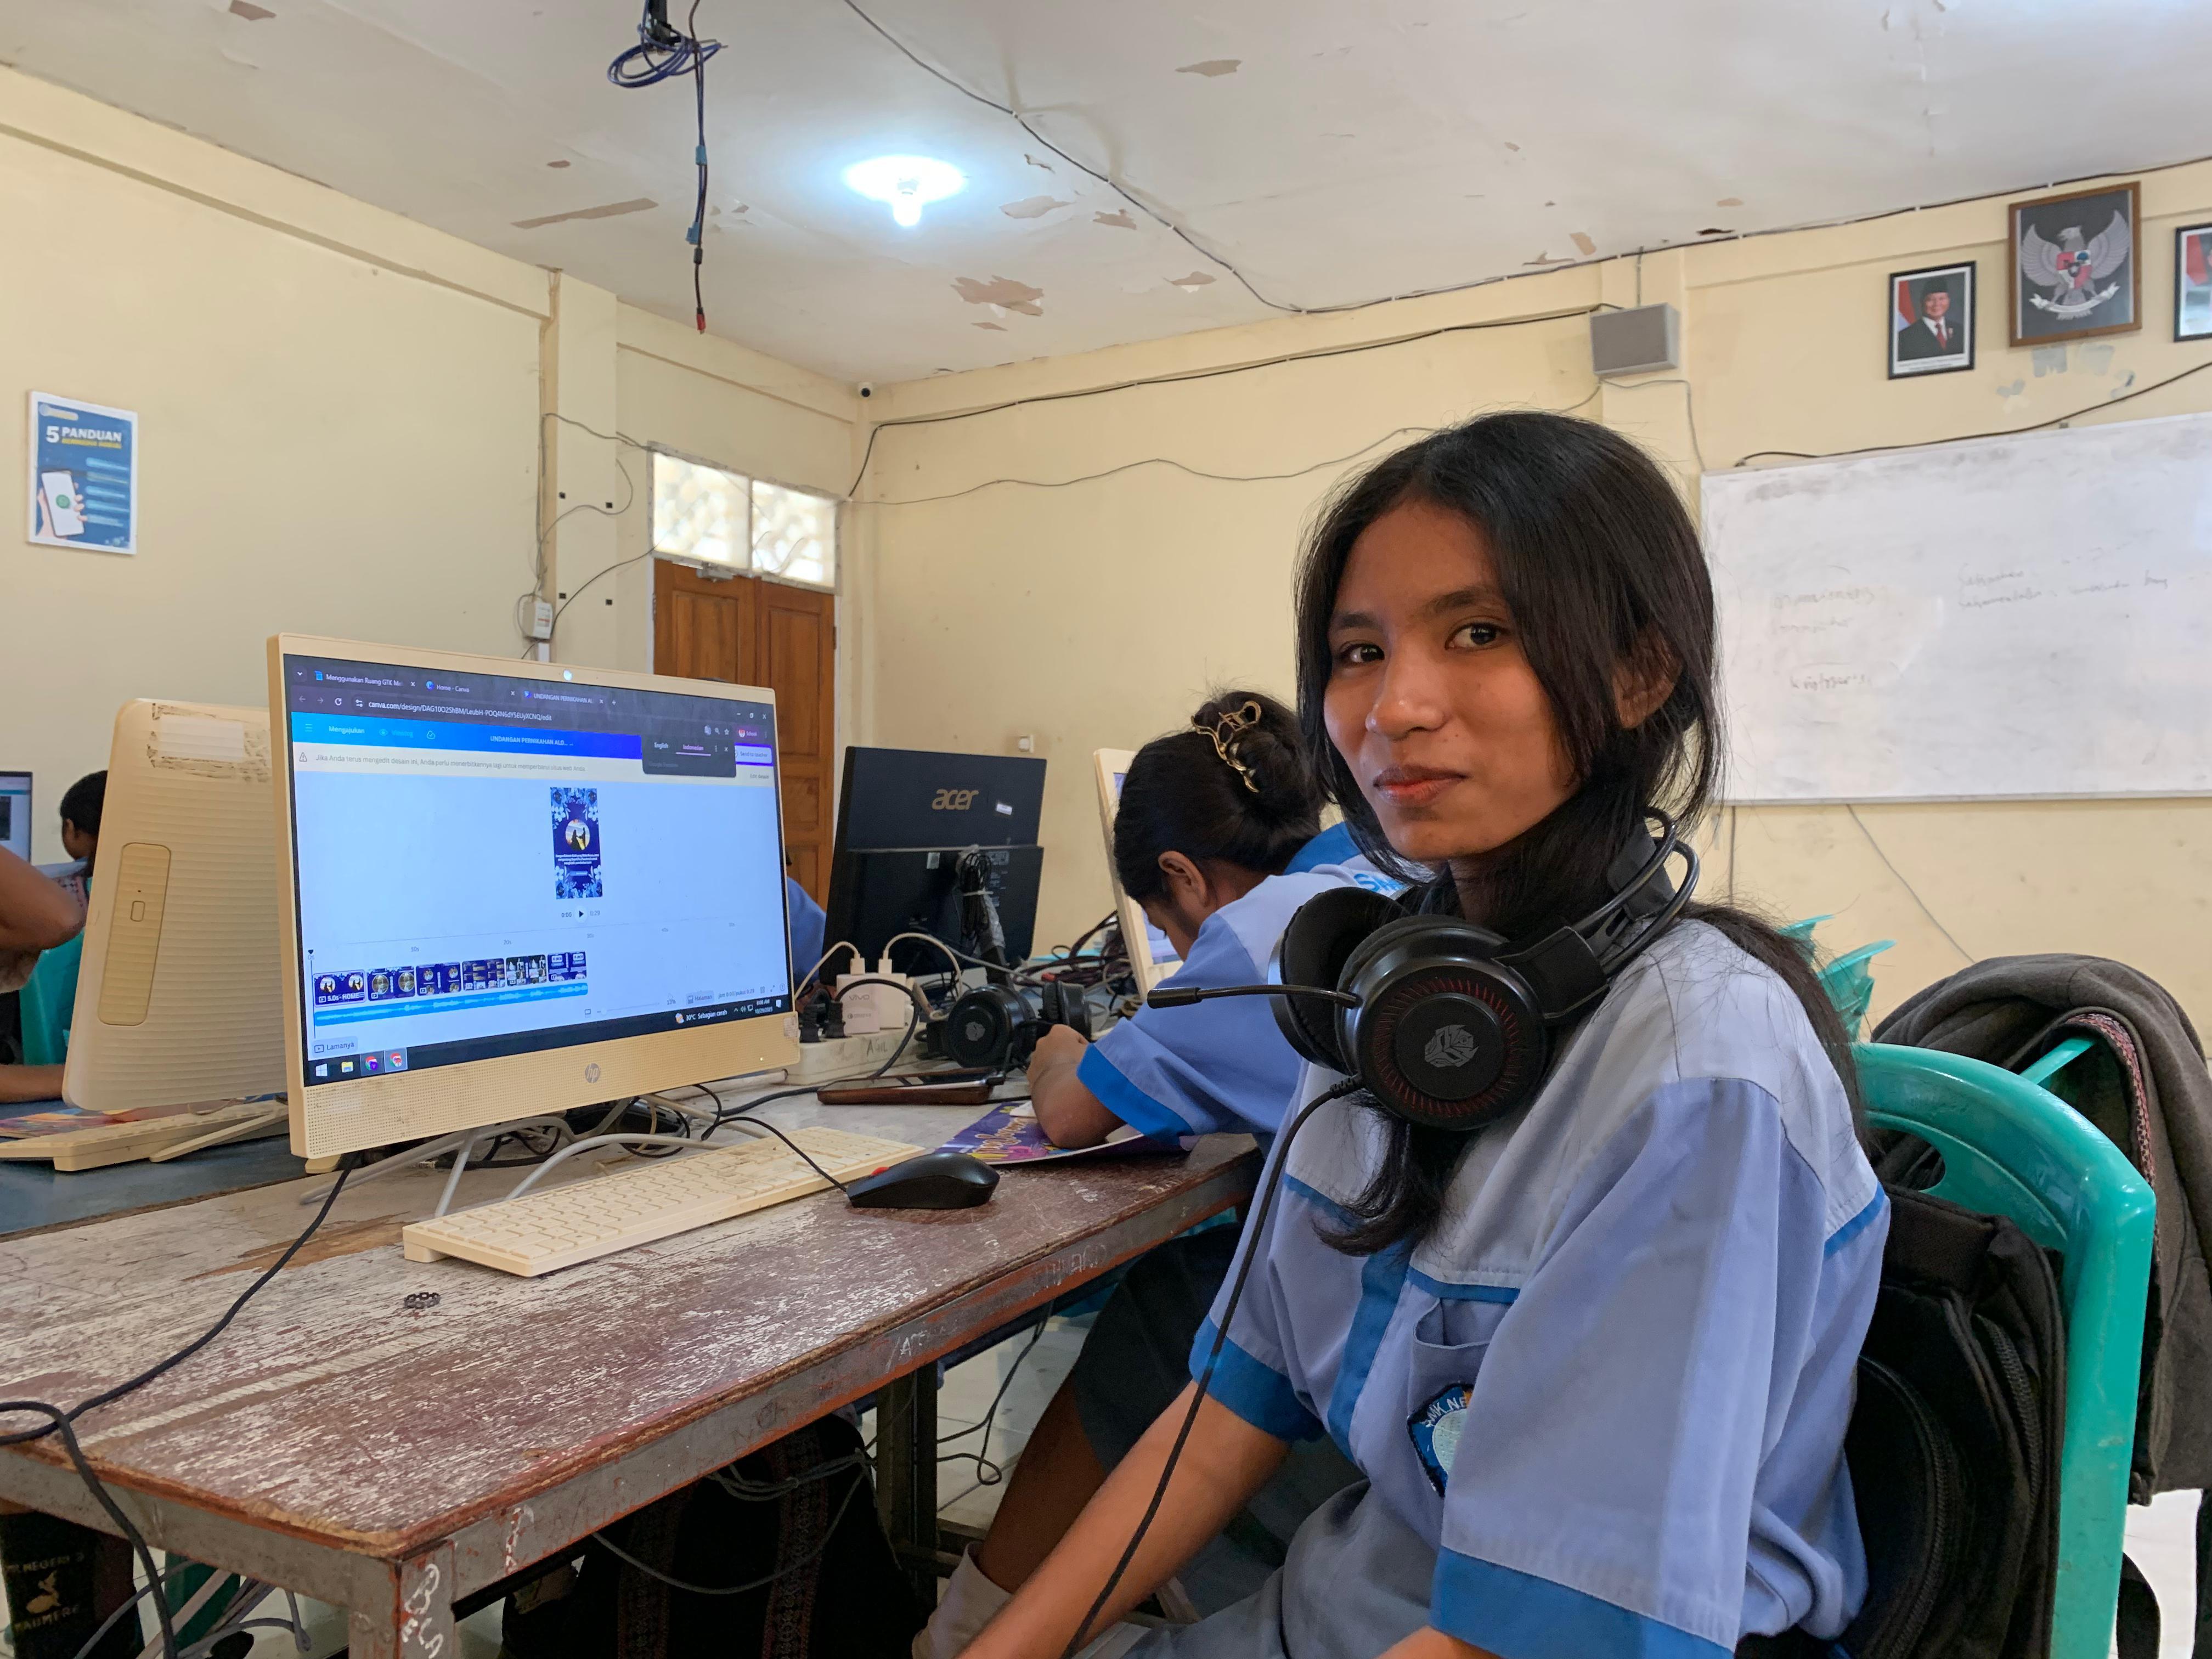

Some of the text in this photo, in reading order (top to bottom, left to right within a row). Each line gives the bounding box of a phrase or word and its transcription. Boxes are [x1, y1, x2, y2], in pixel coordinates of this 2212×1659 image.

[46, 425, 122, 443] 5 PANDUAN
[326, 674, 364, 683] Menggunakan
[365, 678, 381, 686] Ruang
[329, 726, 365, 735] Mengajukan
[450, 760, 492, 769] menerbitkannya
[932, 789, 979, 810] acer
